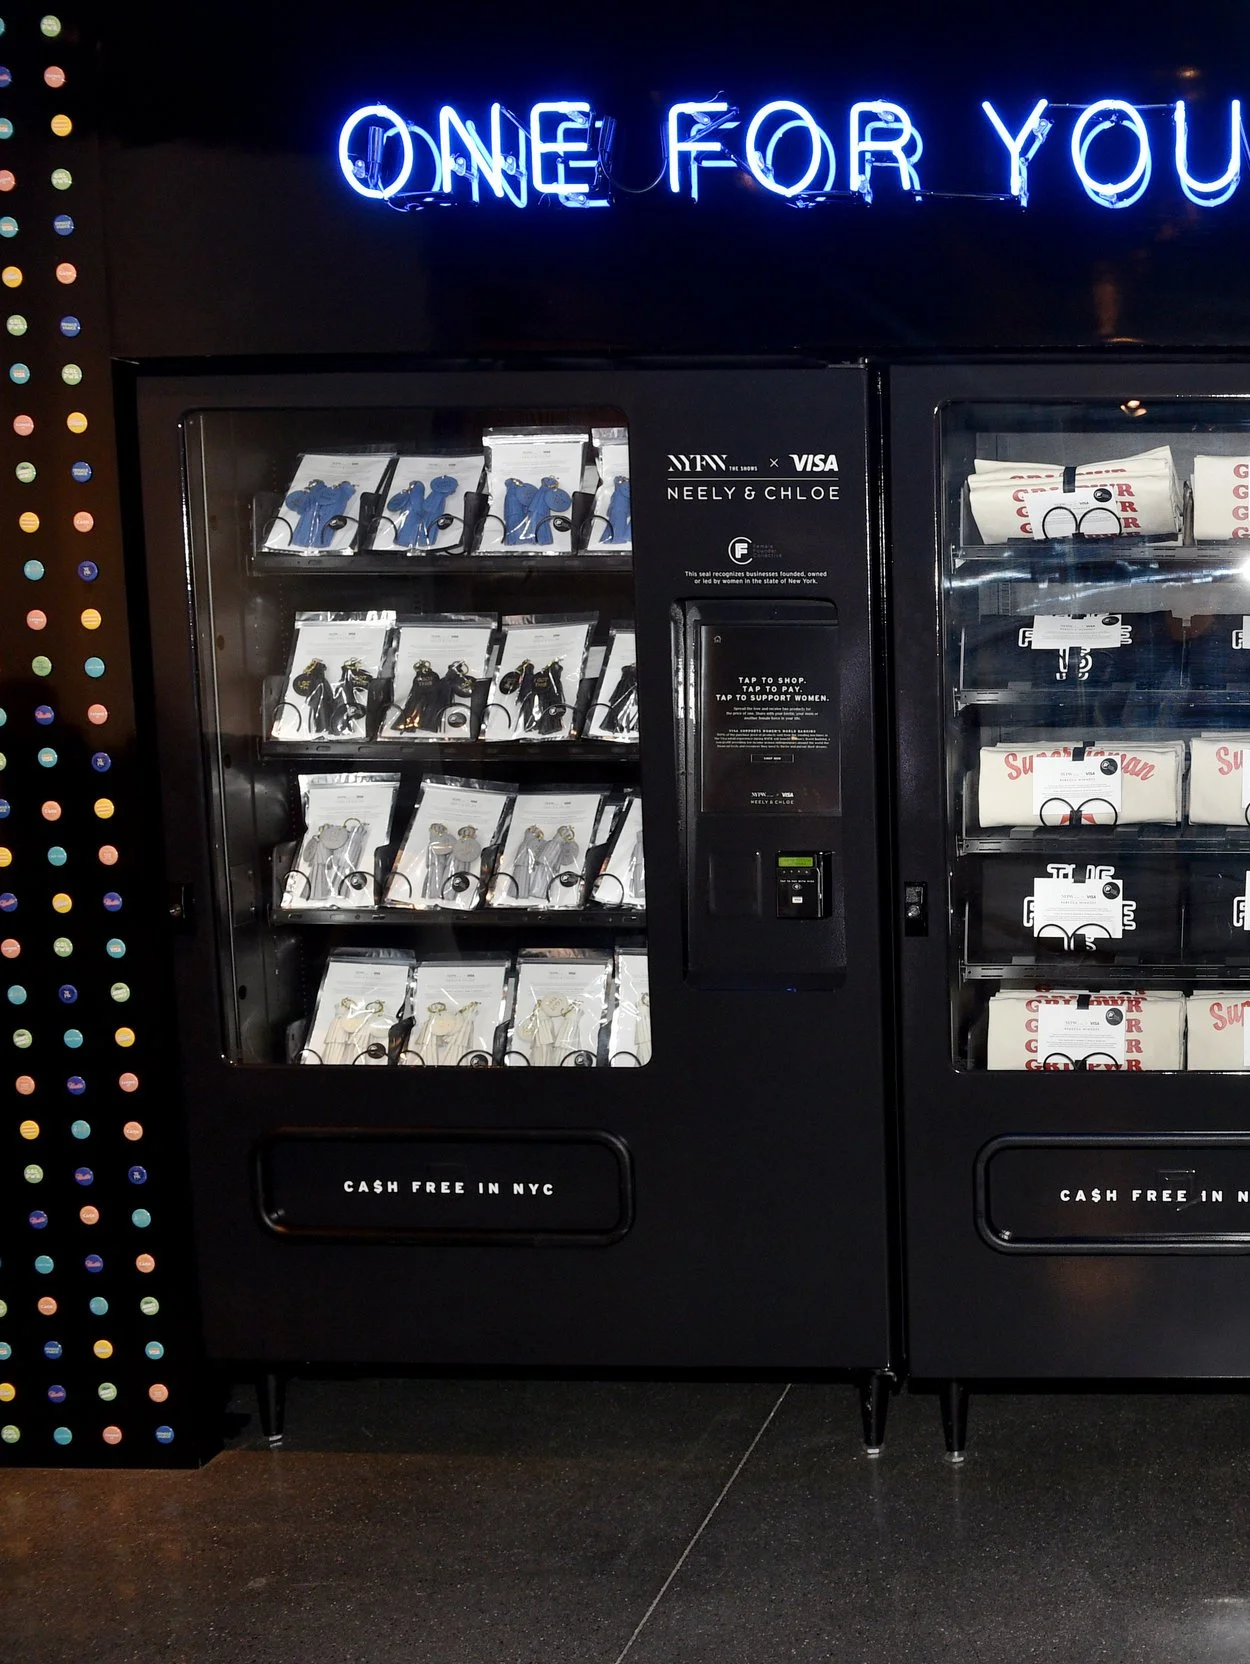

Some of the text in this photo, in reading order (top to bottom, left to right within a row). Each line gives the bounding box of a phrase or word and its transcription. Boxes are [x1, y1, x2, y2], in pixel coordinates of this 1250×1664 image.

[339, 101, 590, 199] ONE
[667, 100, 913, 196] FOR
[789, 454, 839, 472] VISA
[667, 486, 840, 500] NEELY & CHLOE
[712, 571, 745, 579] recognizes
[713, 578, 721, 586] by
[343, 1180, 554, 1196] CA$H FREE IN NYC
[1060, 1188, 1118, 1203] CA$H
[1131, 1189, 1187, 1203] FREE
[1201, 1190, 1223, 1203] IN
